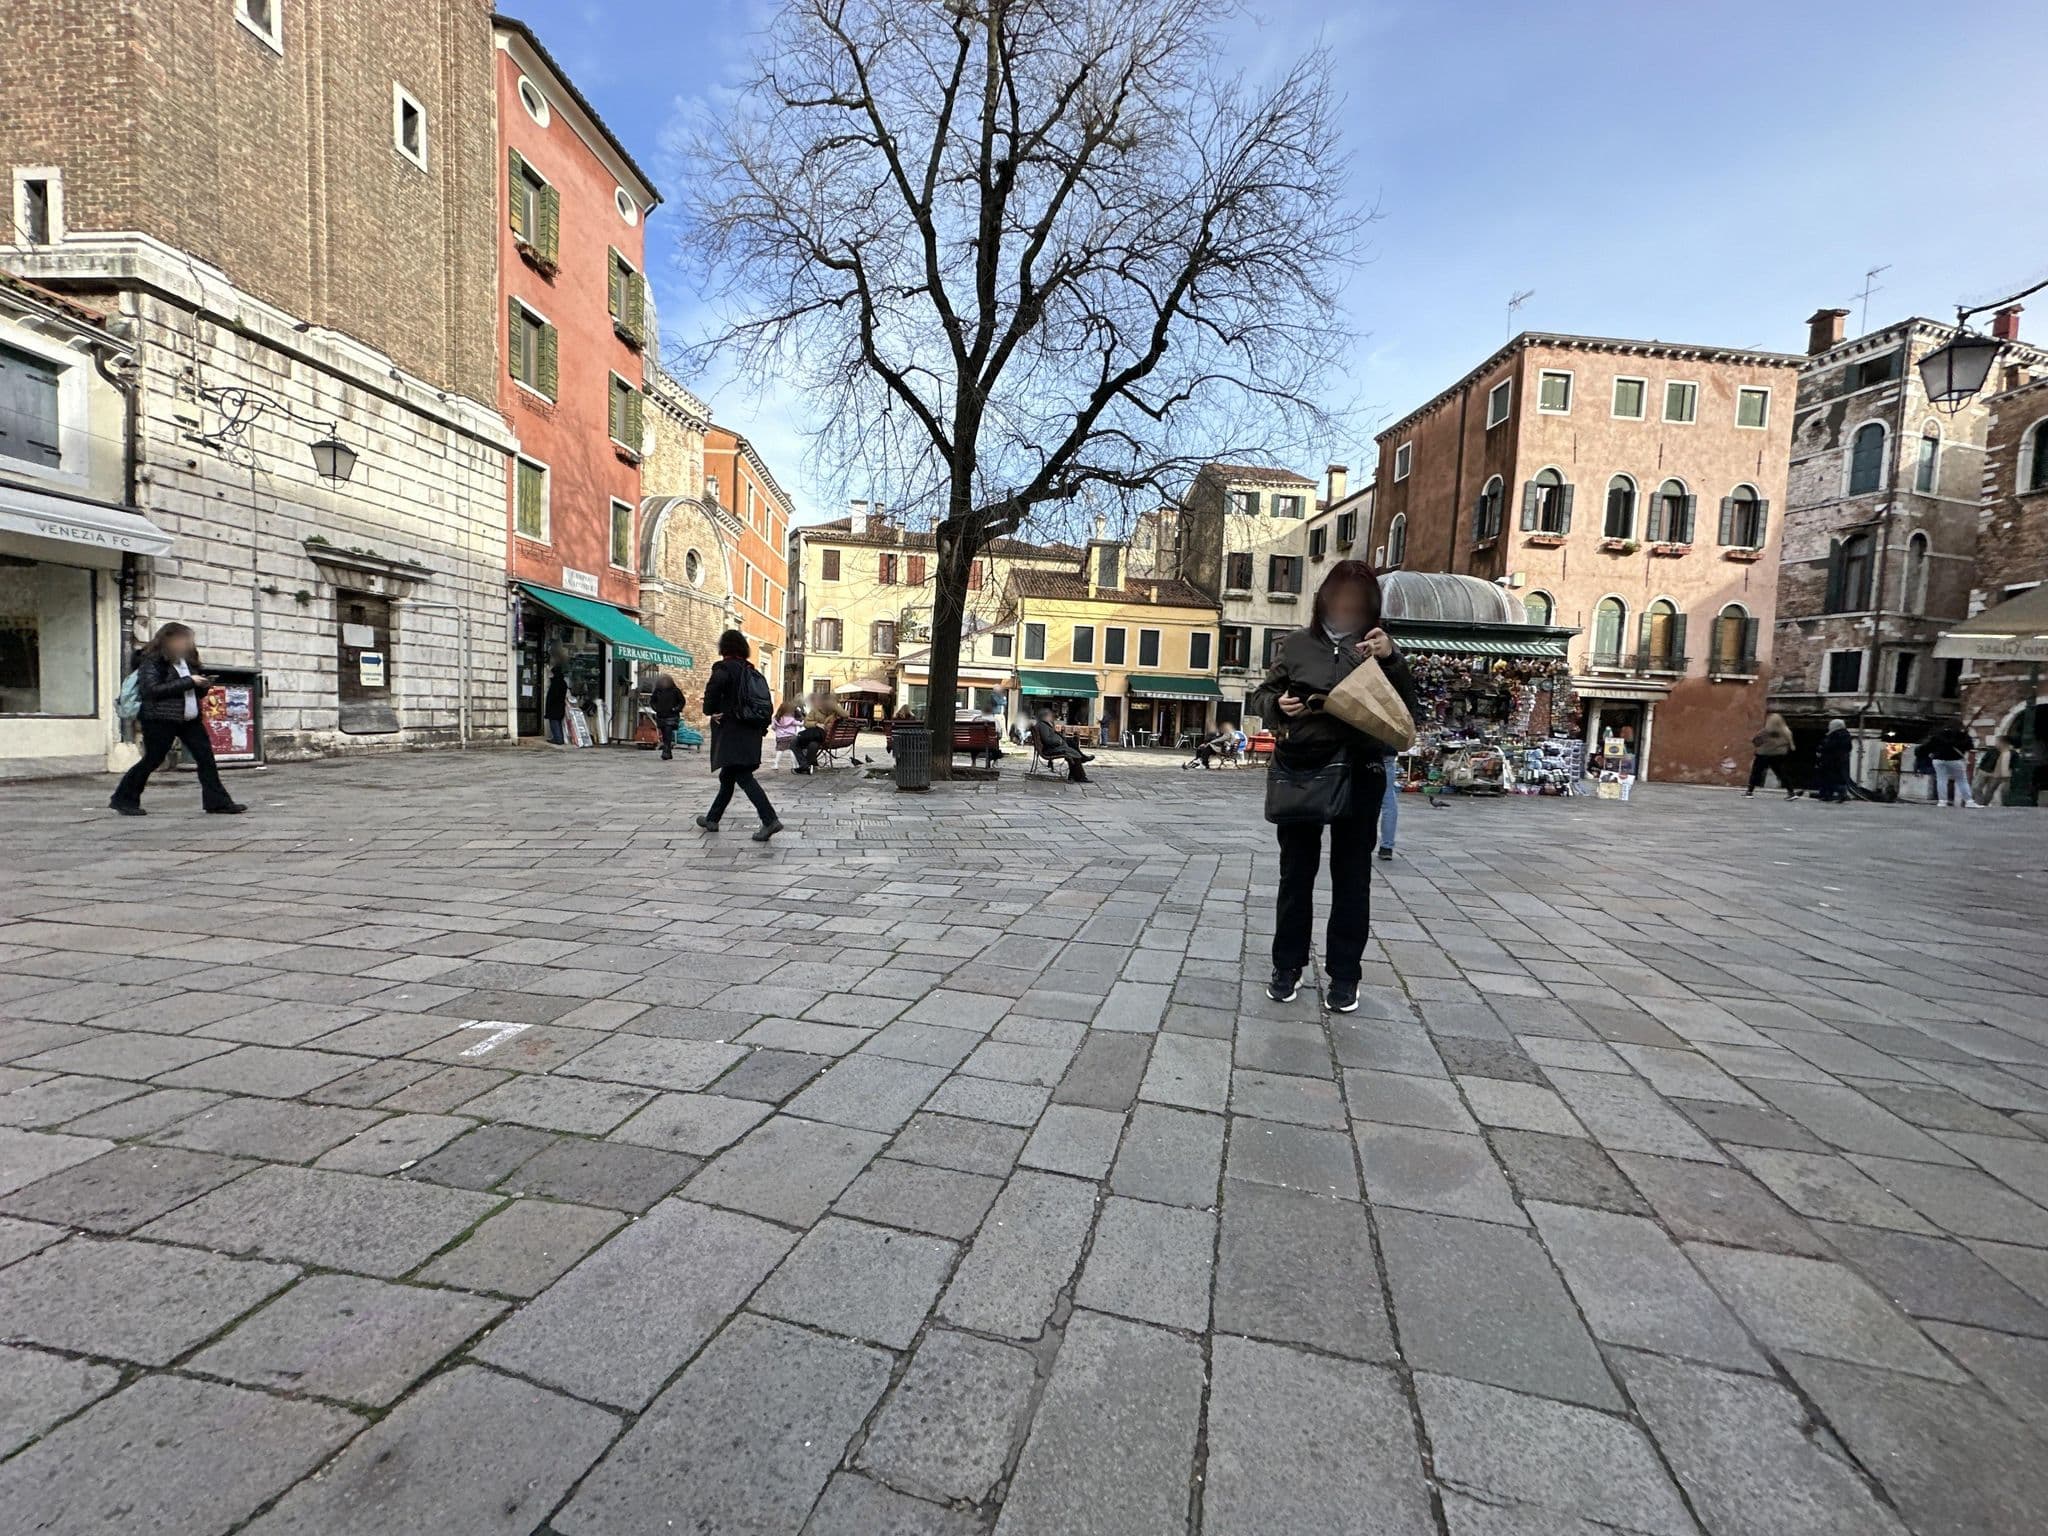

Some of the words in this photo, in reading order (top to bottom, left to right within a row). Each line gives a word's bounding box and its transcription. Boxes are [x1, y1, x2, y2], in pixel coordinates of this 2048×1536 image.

[35, 522, 106, 543] VENEZIA
[112, 536, 131, 547] FC
[618, 646, 662, 662] FERRAMENTA
